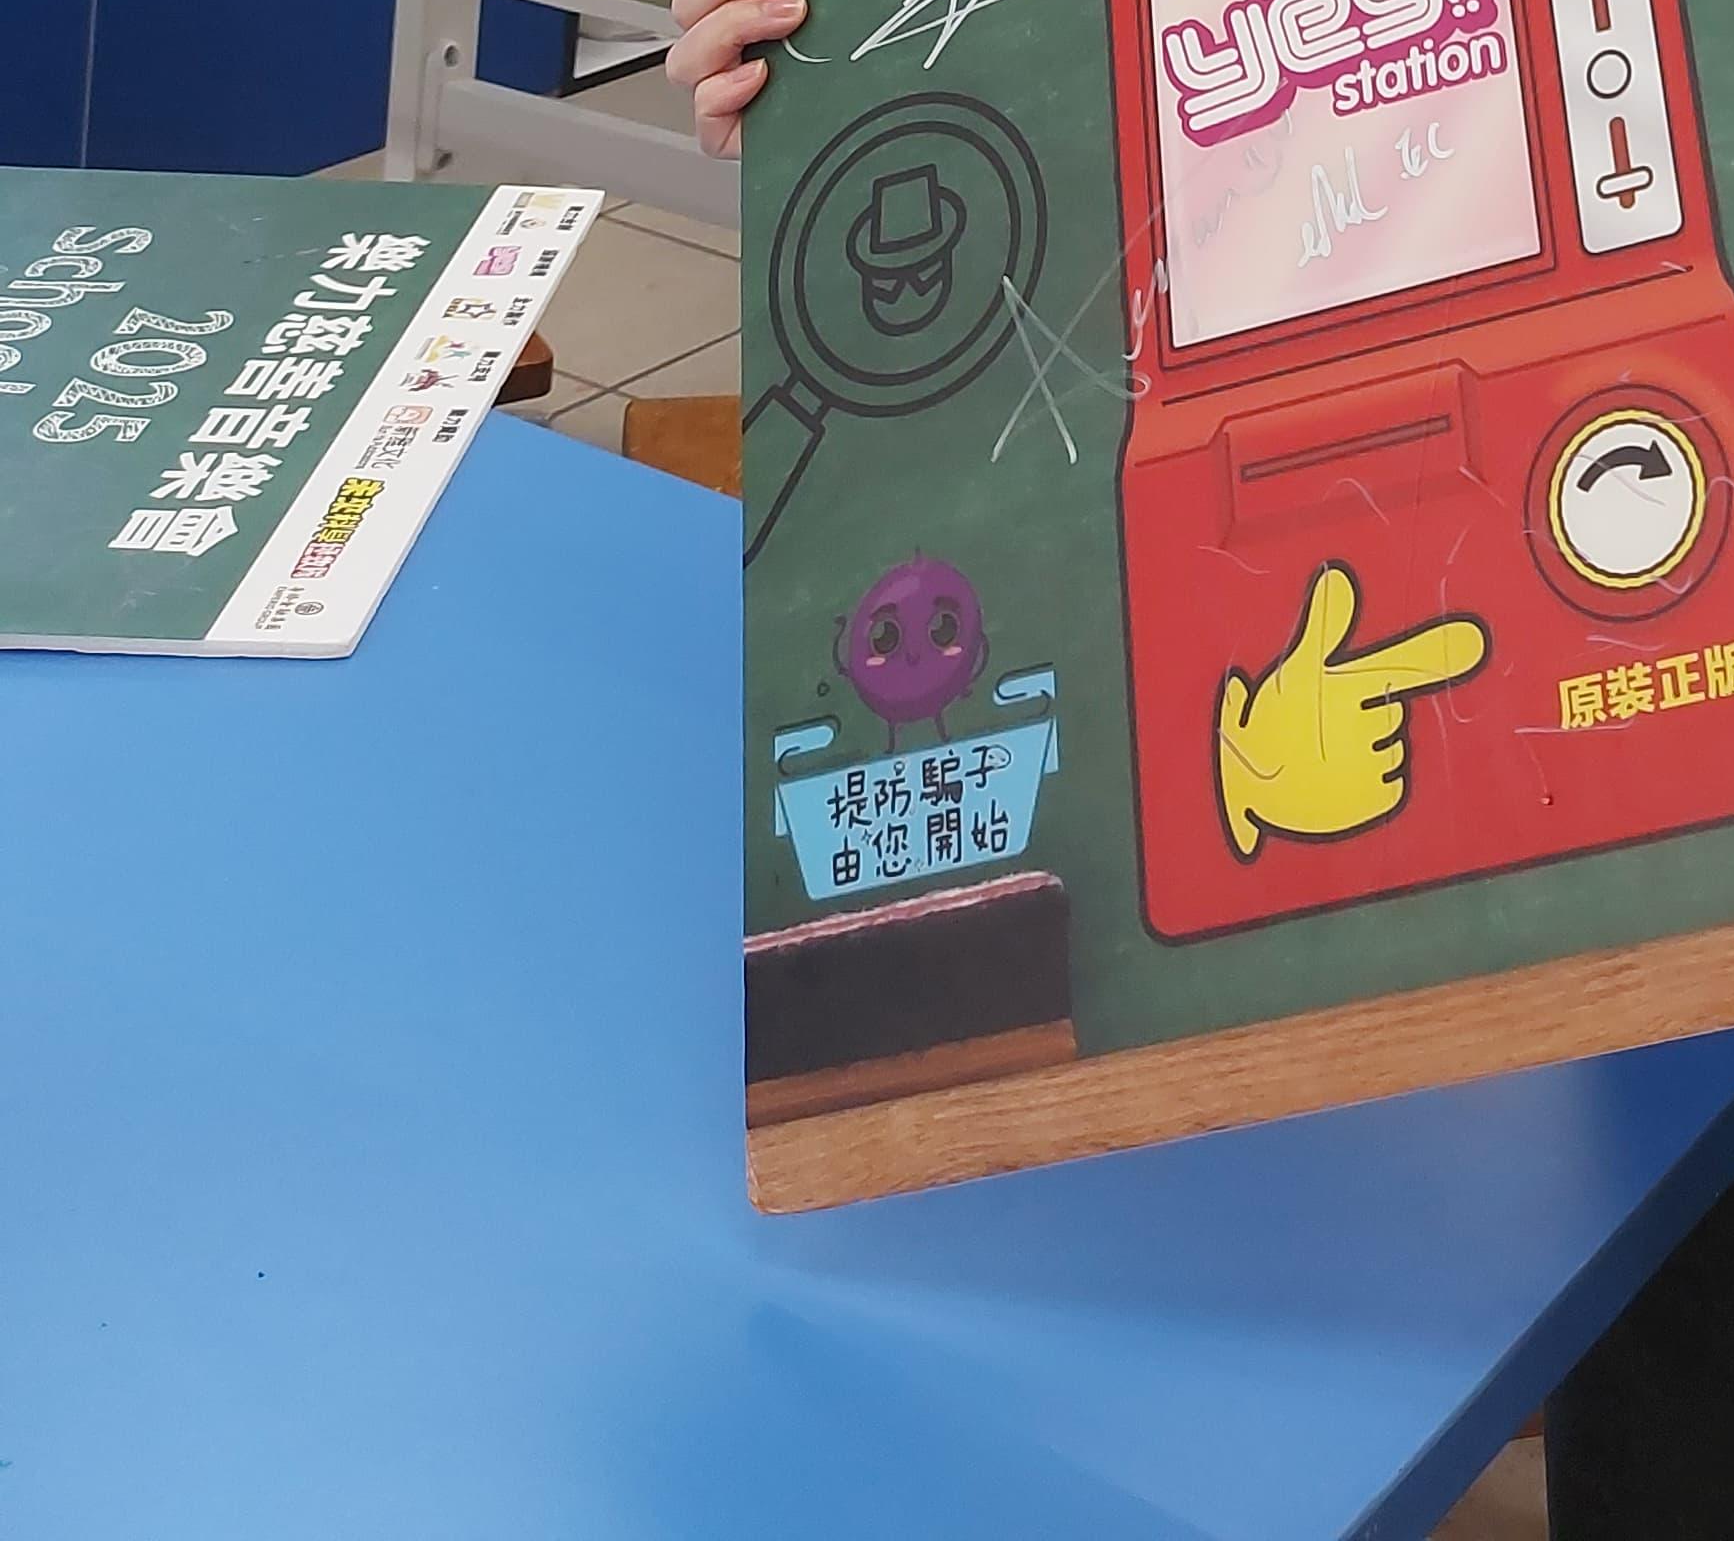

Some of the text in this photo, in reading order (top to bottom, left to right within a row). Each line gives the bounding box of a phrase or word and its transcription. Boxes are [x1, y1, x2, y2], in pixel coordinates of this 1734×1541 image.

[1333, 28, 1506, 116] station
[32, 306, 235, 445] 2025
[108, 230, 432, 558] 樂力慈善音樂會
[827, 745, 1000, 829] 提防騙子
[831, 799, 1010, 887] 由您開始
